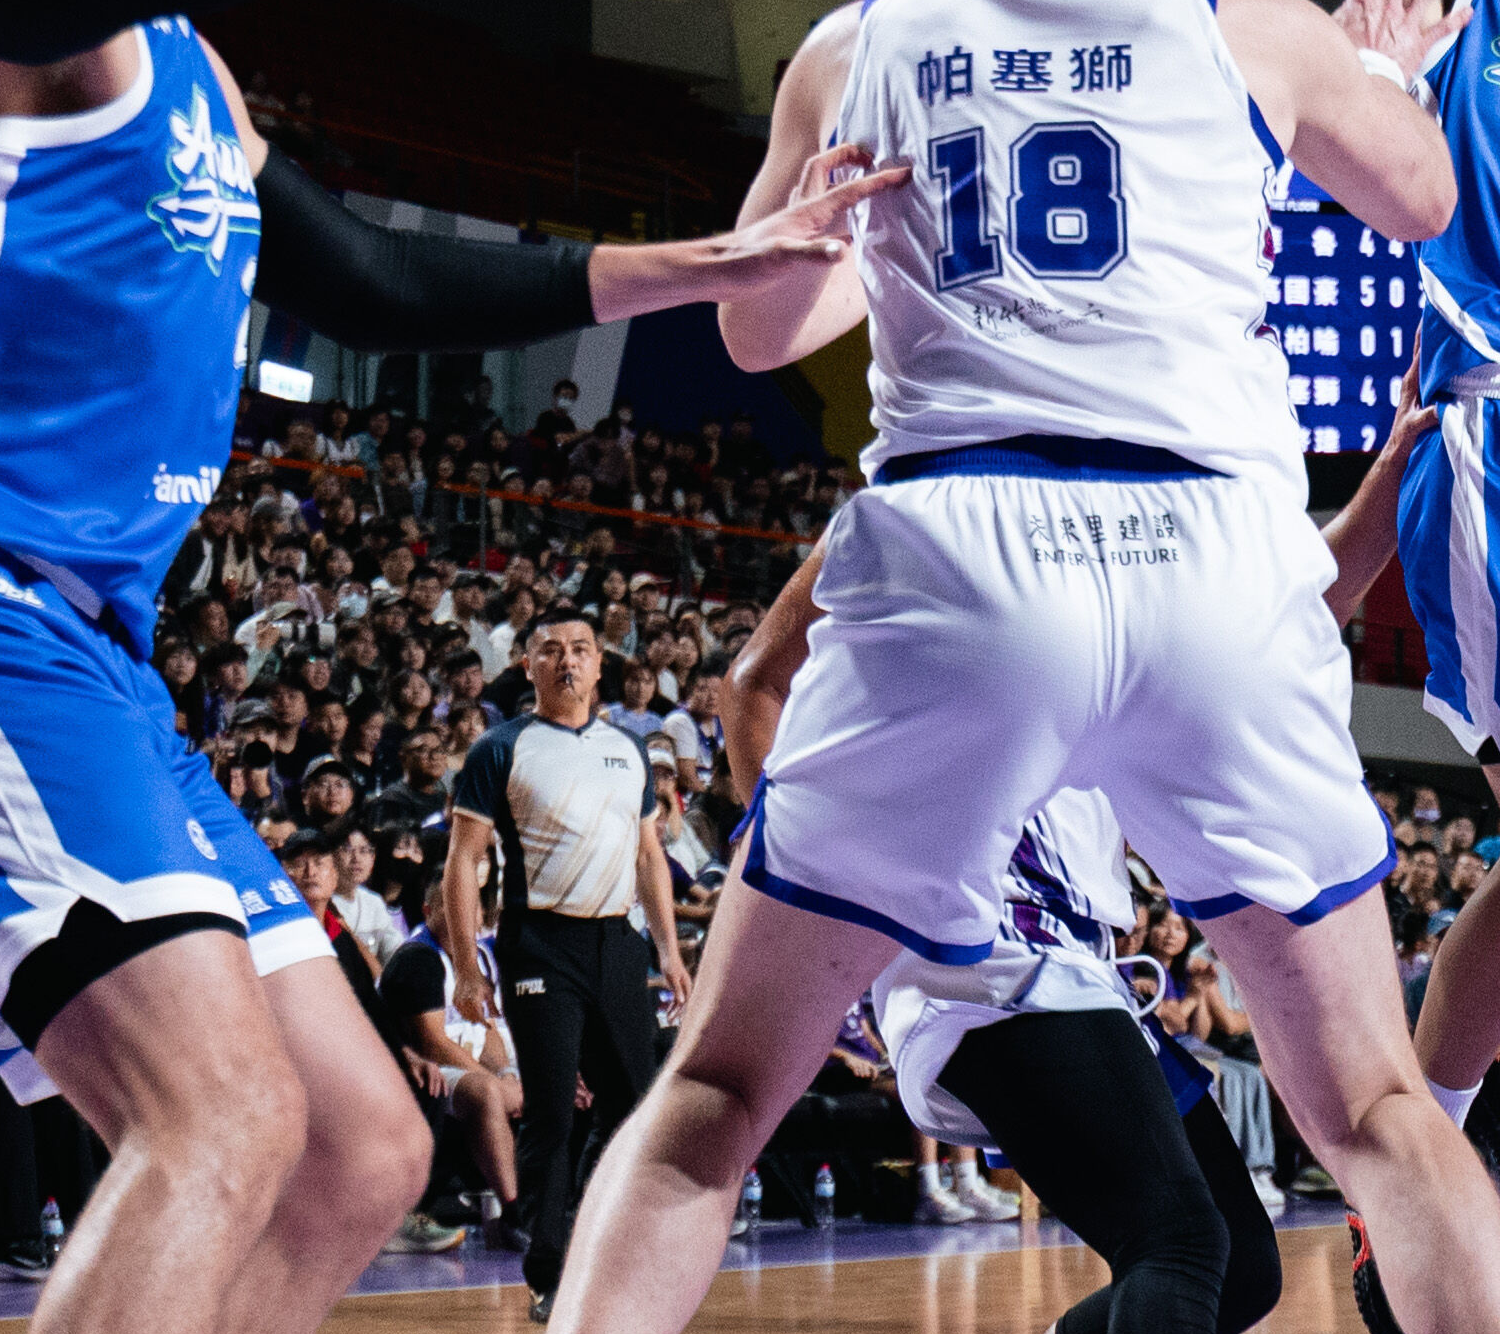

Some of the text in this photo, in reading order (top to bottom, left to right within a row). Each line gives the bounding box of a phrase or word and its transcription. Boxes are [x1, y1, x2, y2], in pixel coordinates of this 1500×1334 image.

[917, 43, 1133, 108] 帕塞獅
[928, 119, 1128, 294] 18
[1359, 276, 1376, 308] 5
[1388, 276, 1405, 307] 0
[1359, 325, 1377, 357] 0
[1389, 325, 1403, 358] 1
[1359, 374, 1377, 407] 4
[1110, 548, 1180, 566] FUTURE
